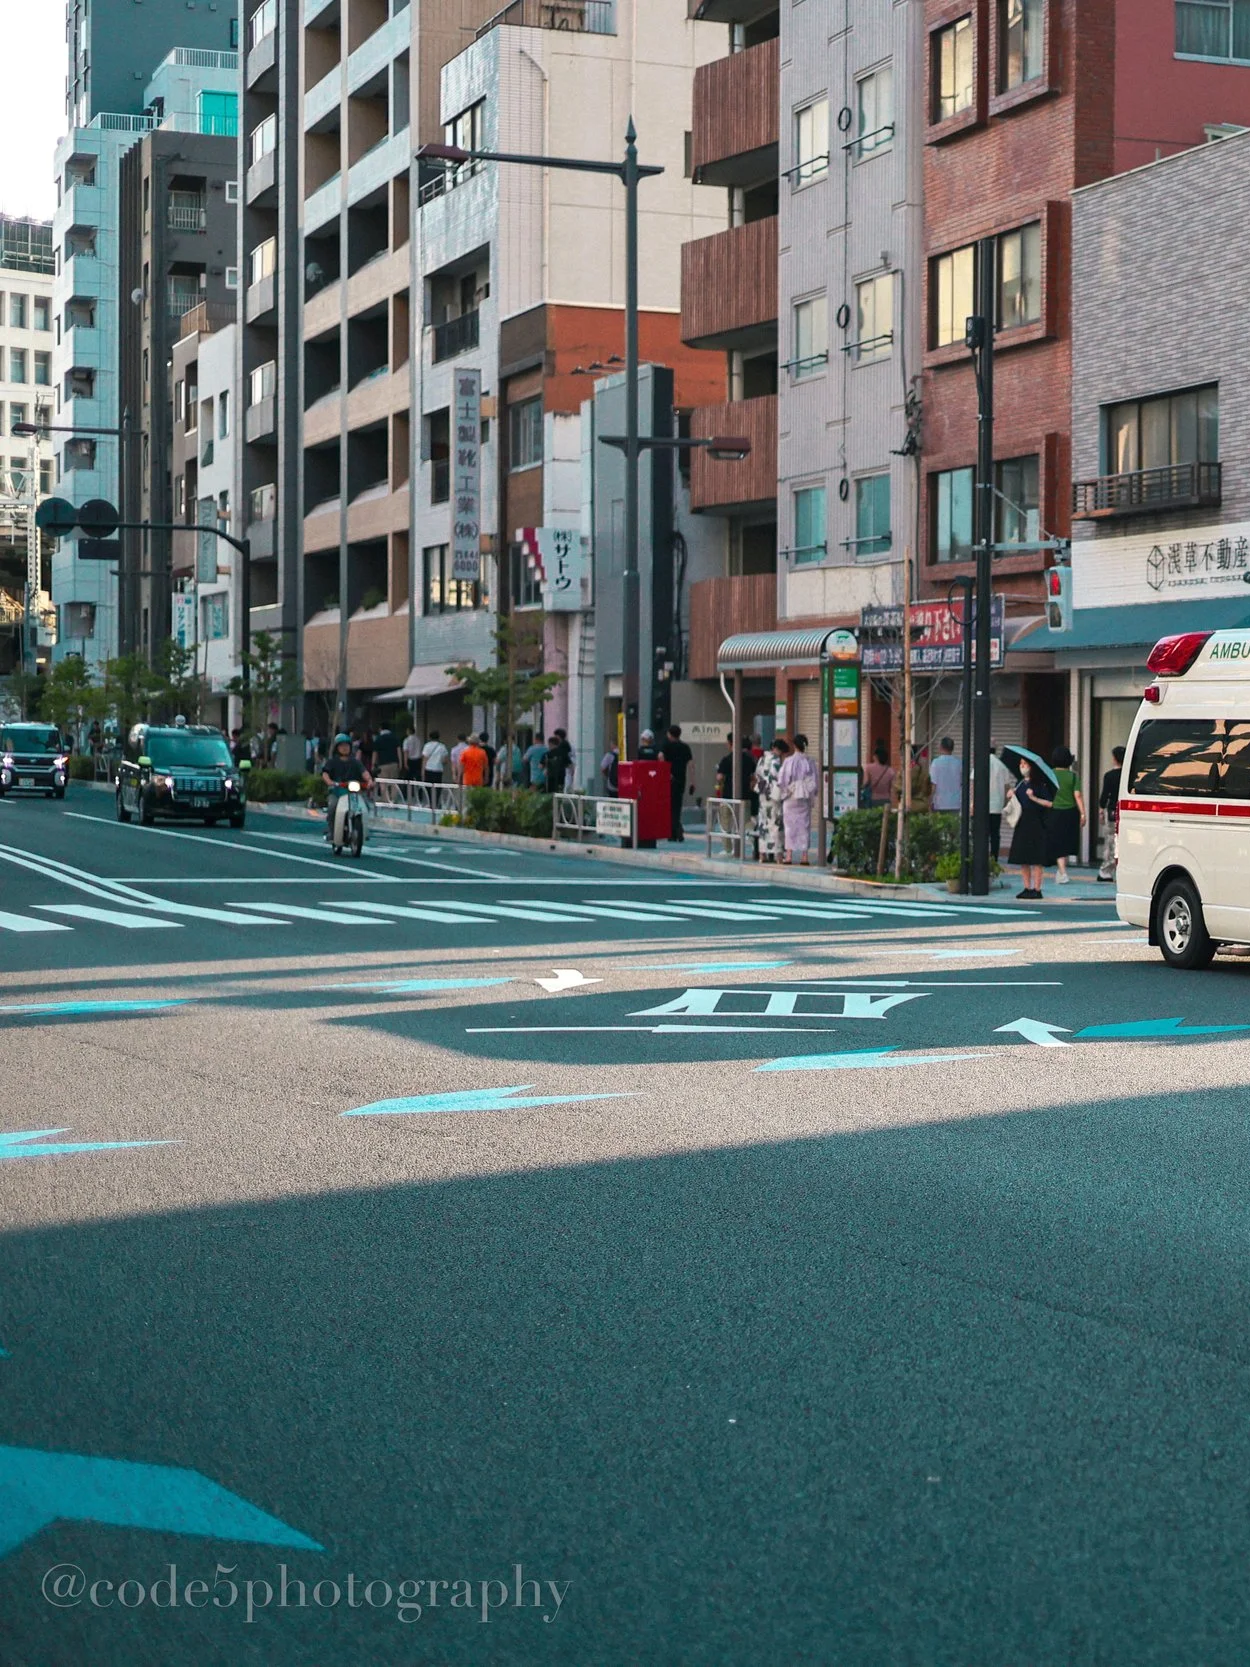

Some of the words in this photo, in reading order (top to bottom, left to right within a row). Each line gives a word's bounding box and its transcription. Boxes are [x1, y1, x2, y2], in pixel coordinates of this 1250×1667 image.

[1167, 536, 1249, 574] 浅草不動産
